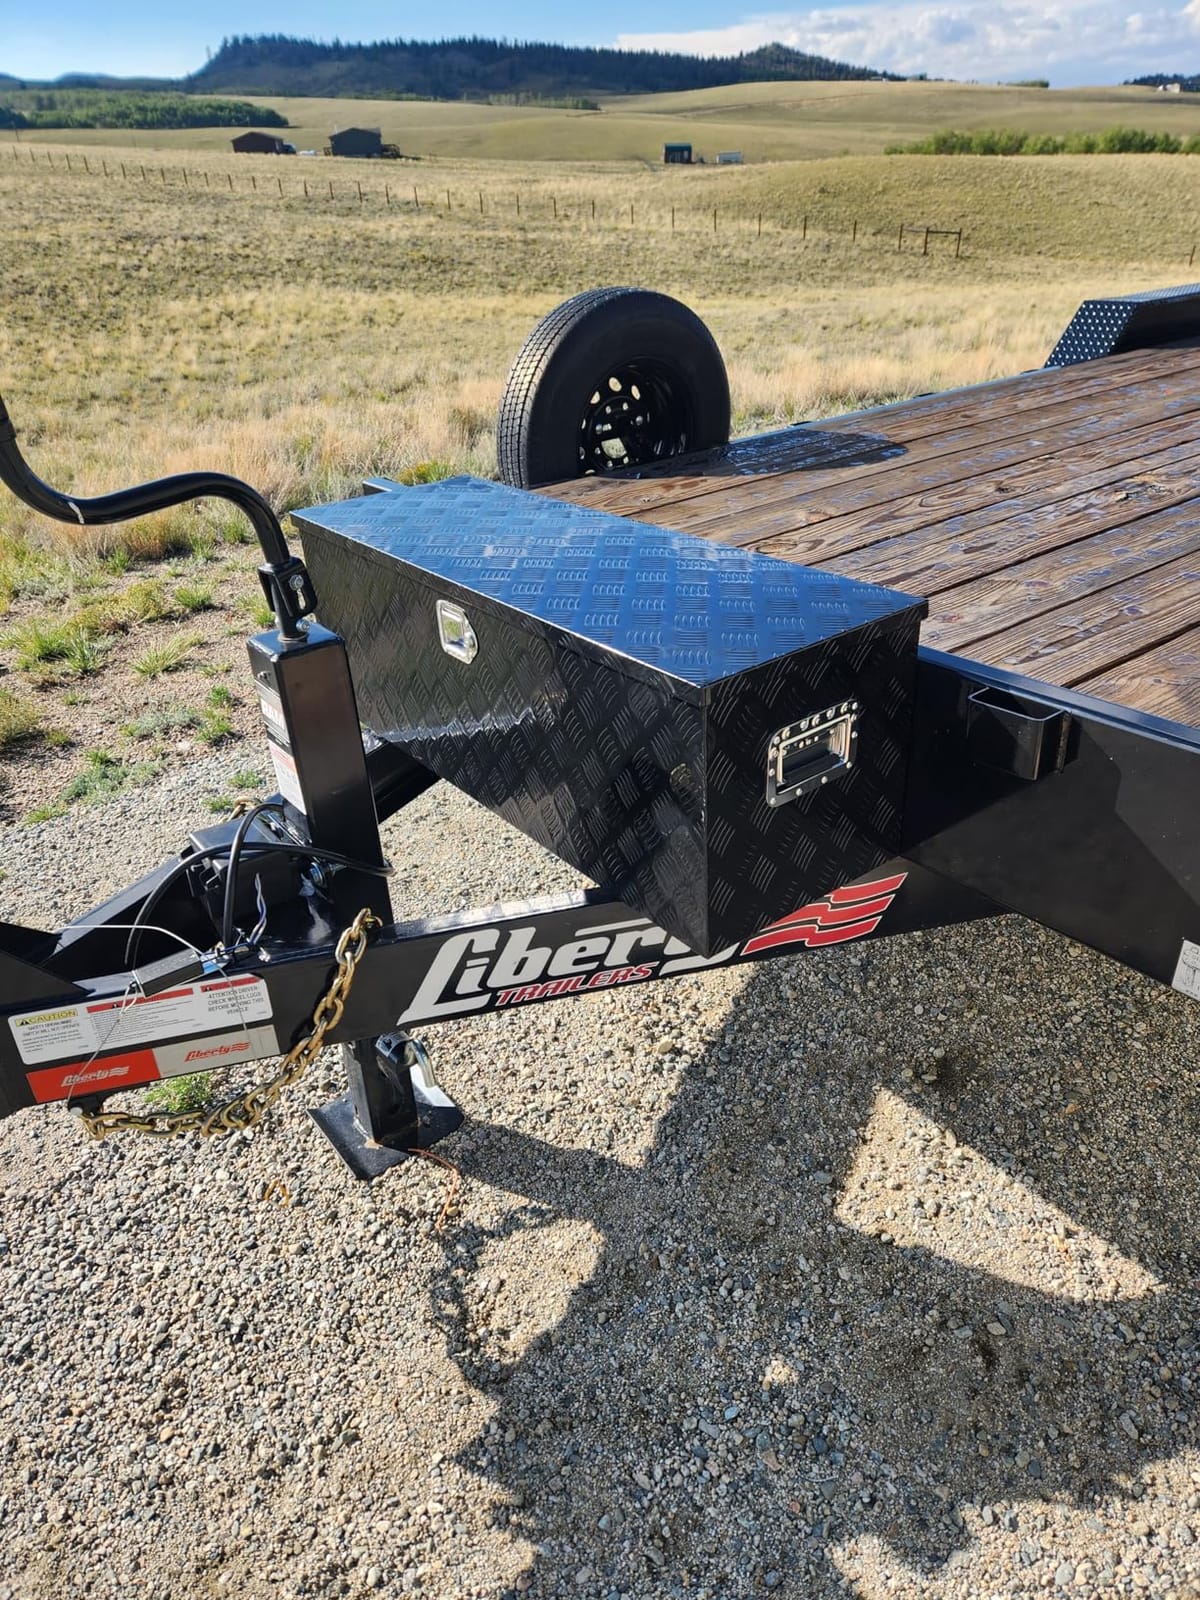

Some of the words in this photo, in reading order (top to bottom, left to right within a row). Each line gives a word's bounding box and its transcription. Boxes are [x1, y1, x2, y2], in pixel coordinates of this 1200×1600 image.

[496, 962, 659, 1006] TRAILERS
[208, 989, 237, 999] ATTENTION
[238, 985, 258, 993] DRIVER
[208, 998, 226, 1006] CHECK
[228, 994, 246, 1002] WHEEL
[208, 1004, 229, 1012] BEFORE
[230, 999, 252, 1008] MOVING
[28, 1010, 76, 1024] CAUTION
[227, 1006, 249, 1015] VEHICLE
[184, 1045, 231, 1062] Liberty
[60, 1070, 108, 1087] Liberty
